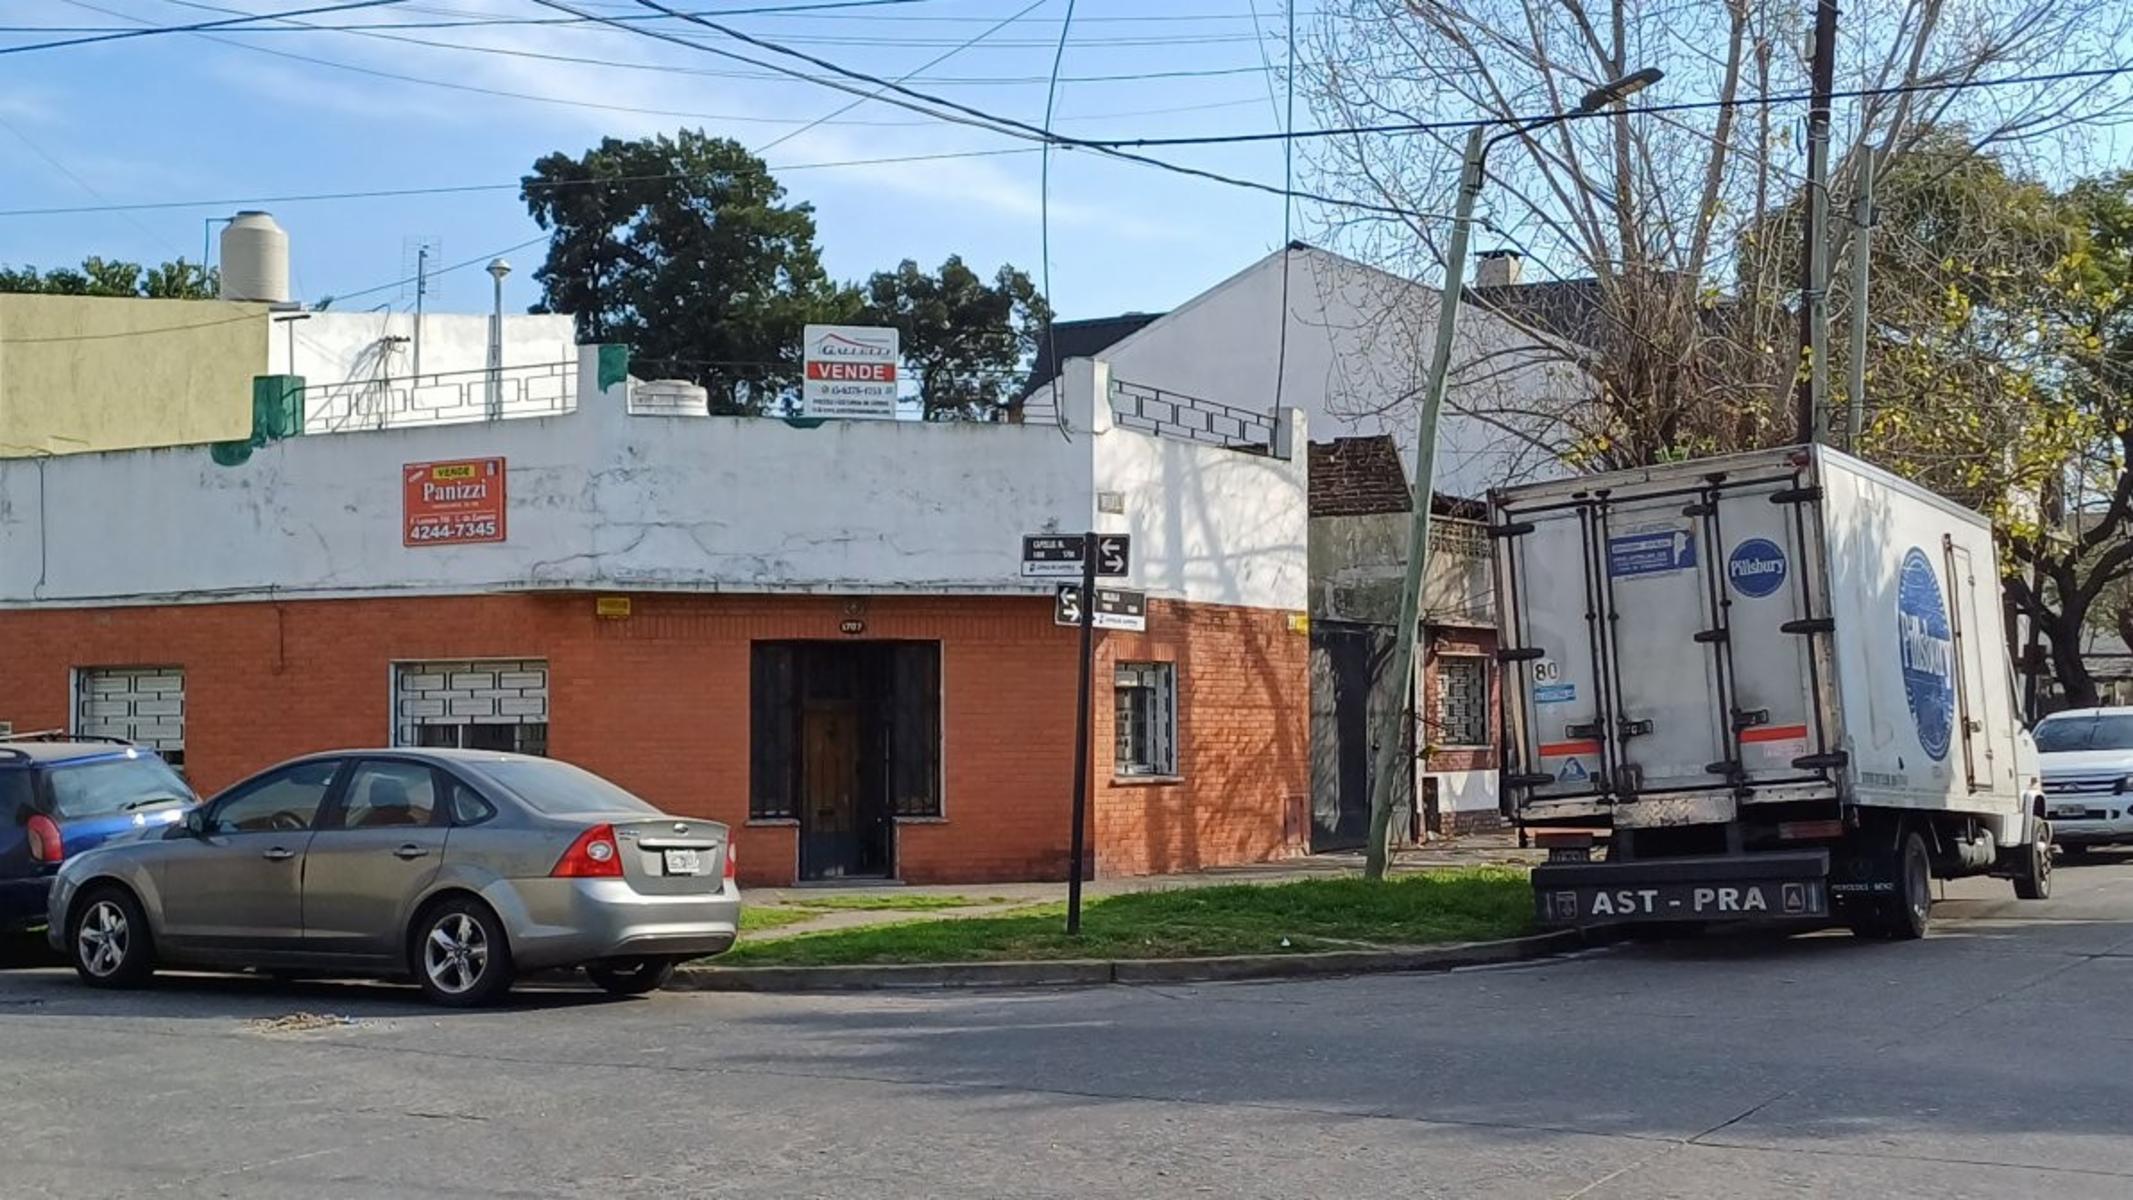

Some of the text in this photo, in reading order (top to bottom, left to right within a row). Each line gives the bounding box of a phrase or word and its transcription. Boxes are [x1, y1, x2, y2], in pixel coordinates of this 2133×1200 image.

[818, 363, 885, 380] VENDE
[437, 467, 470, 477] VENDE
[423, 478, 487, 502] Panizzi
[410, 522, 496, 540] 4244-7345
[1731, 558, 1785, 577] Pillsbury
[1900, 610, 1953, 690] Pillsbury
[1535, 662, 1558, 681] 80
[1591, 889, 1659, 915] AST
[1693, 886, 1767, 912] PRA
